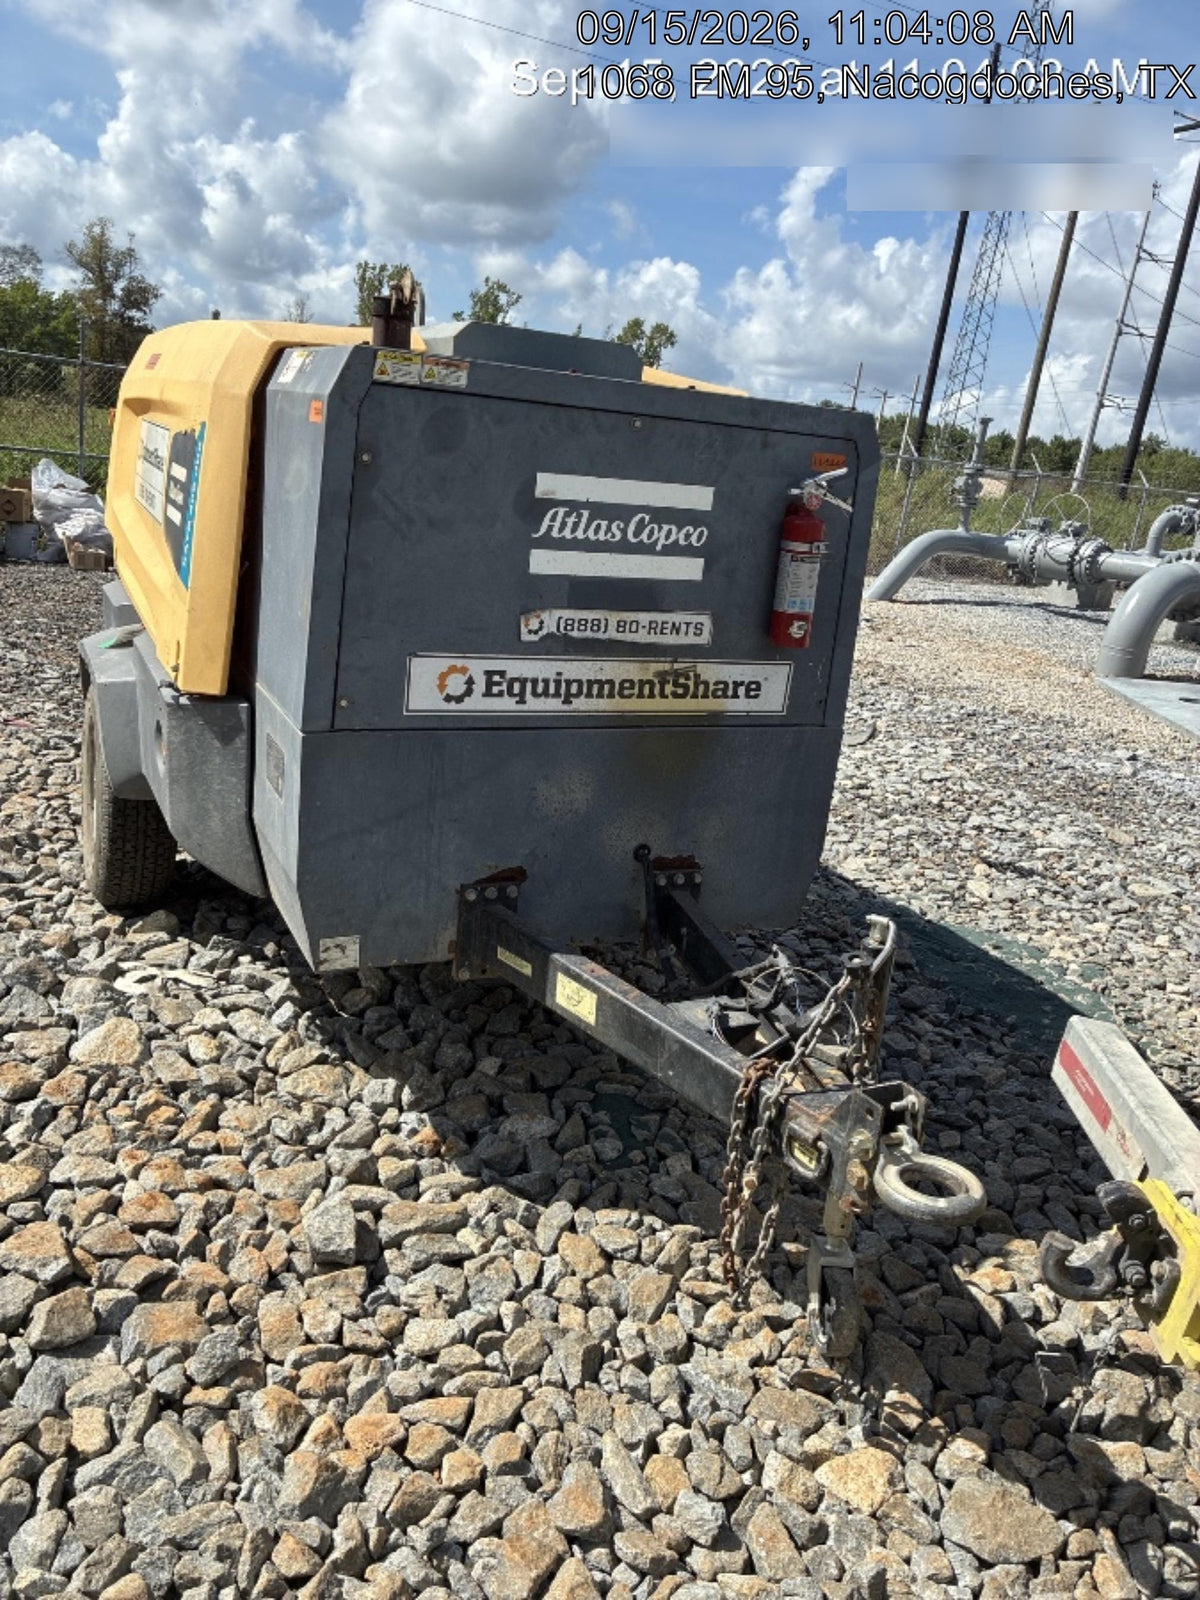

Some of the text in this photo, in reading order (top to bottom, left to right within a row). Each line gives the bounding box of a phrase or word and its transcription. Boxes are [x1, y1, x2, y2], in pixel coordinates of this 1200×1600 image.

[531, 506, 708, 551] Atlas Copco
[555, 616, 609, 634] (888)
[481, 669, 762, 705] EquipmentShare
